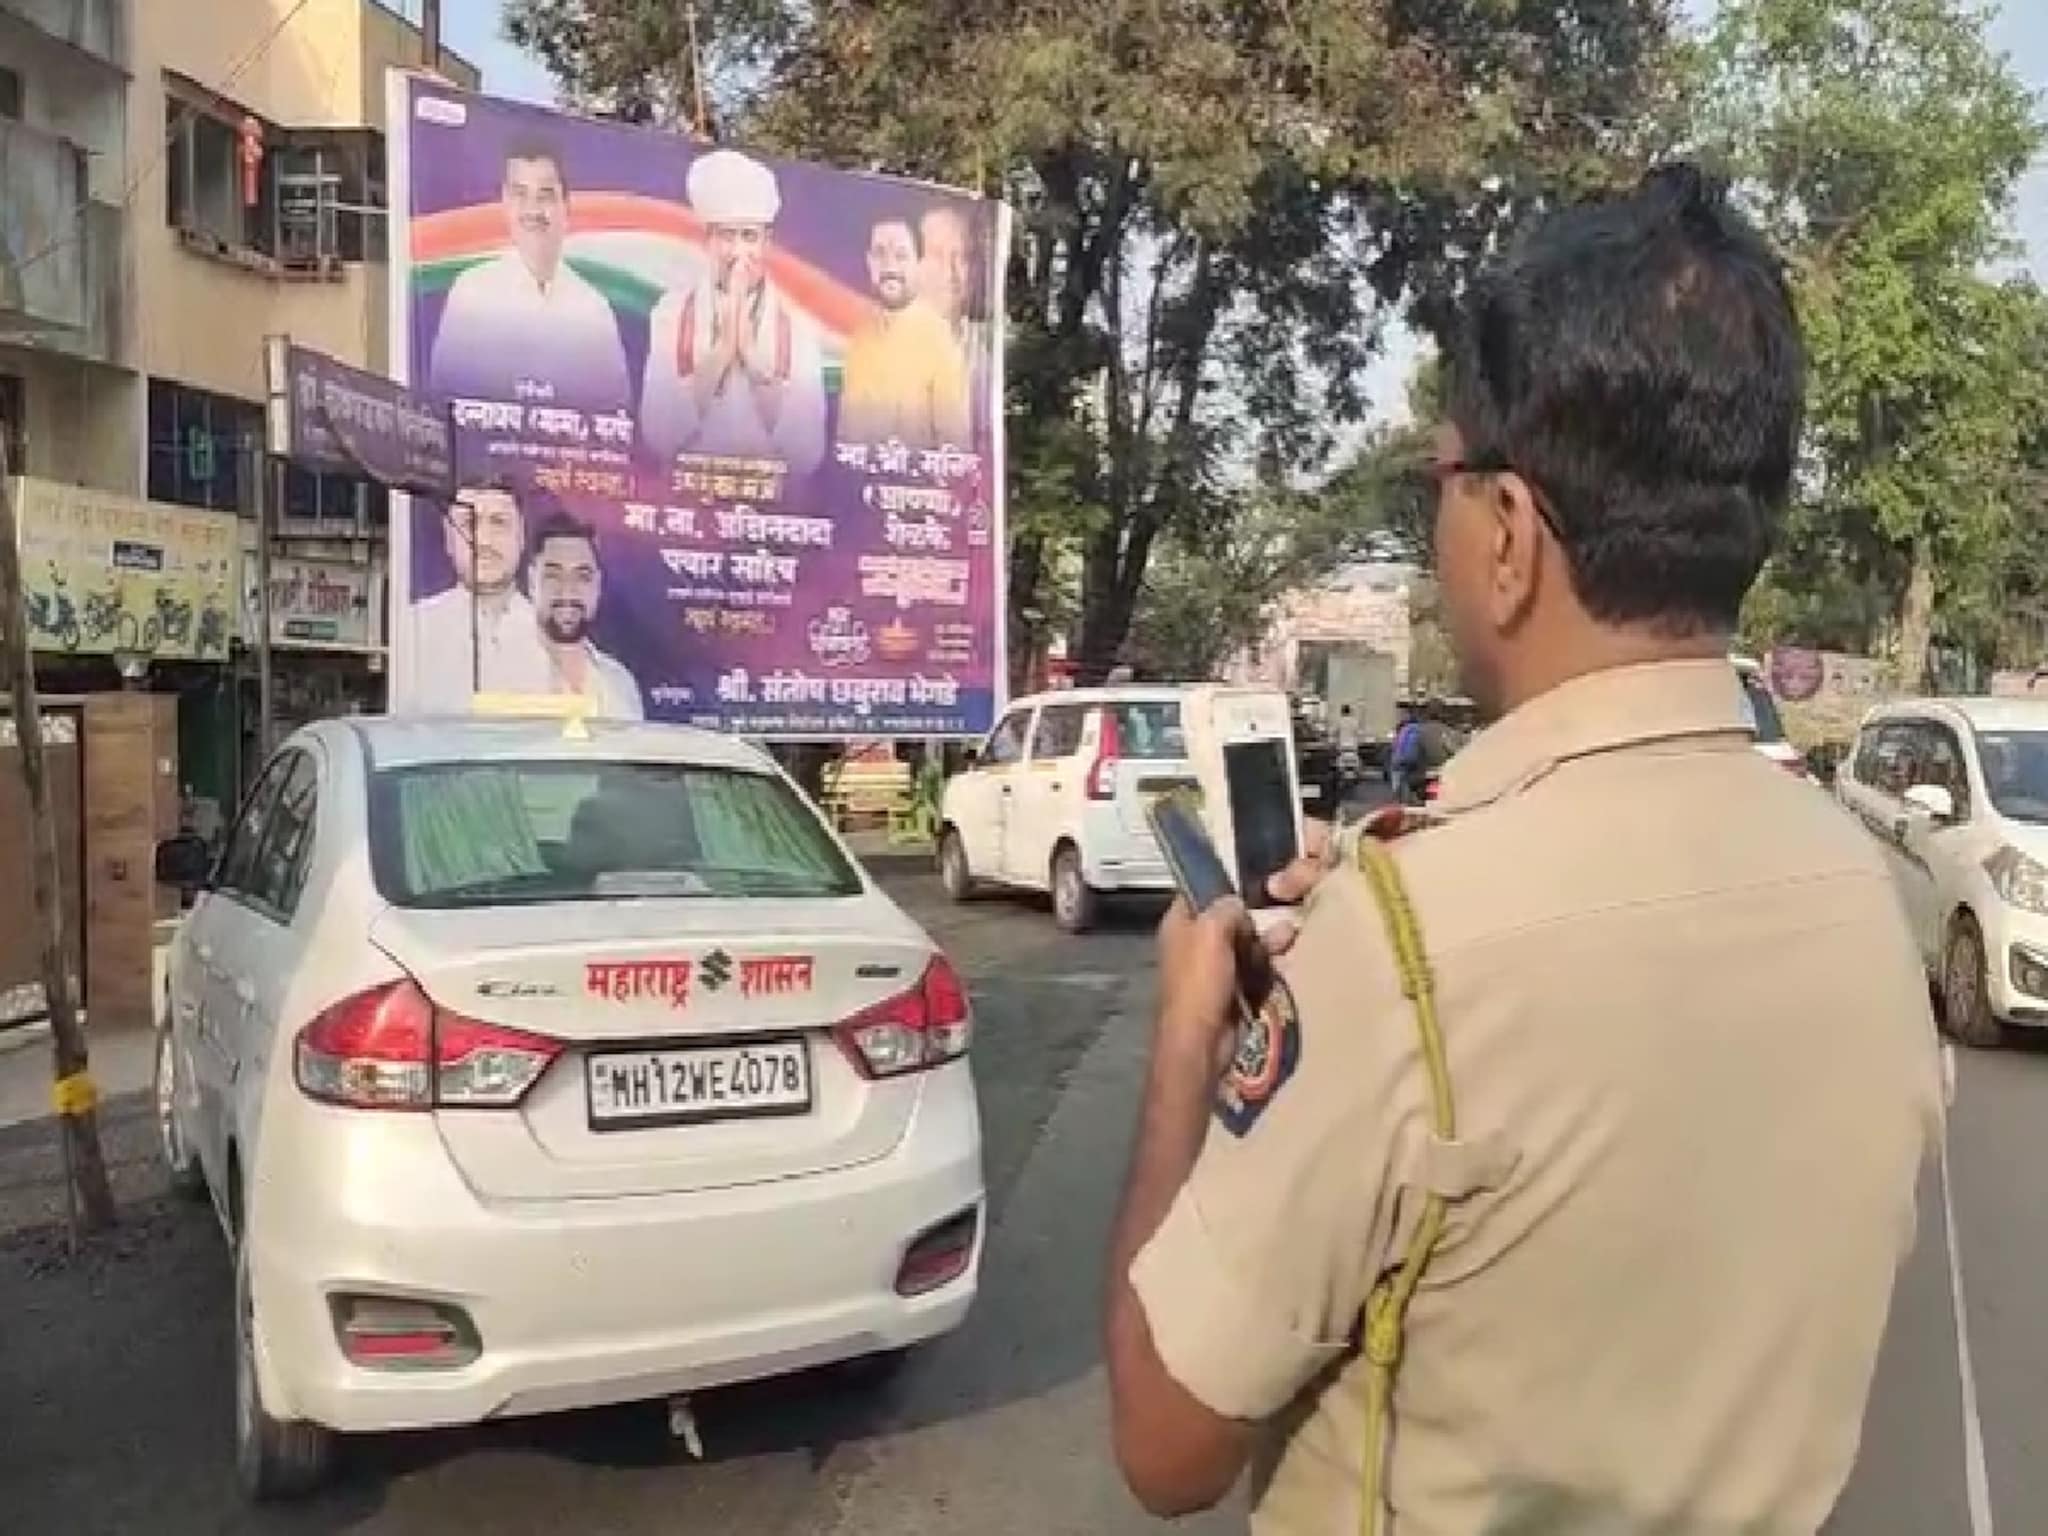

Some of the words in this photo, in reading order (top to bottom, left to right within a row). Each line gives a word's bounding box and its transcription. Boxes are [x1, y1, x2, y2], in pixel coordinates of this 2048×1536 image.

[761, 668, 826, 705] संतोष
[584, 960, 691, 1008] महाराष्ट्र
[740, 956, 814, 998] शासन
[611, 1053, 800, 1107] MH12WE4078
